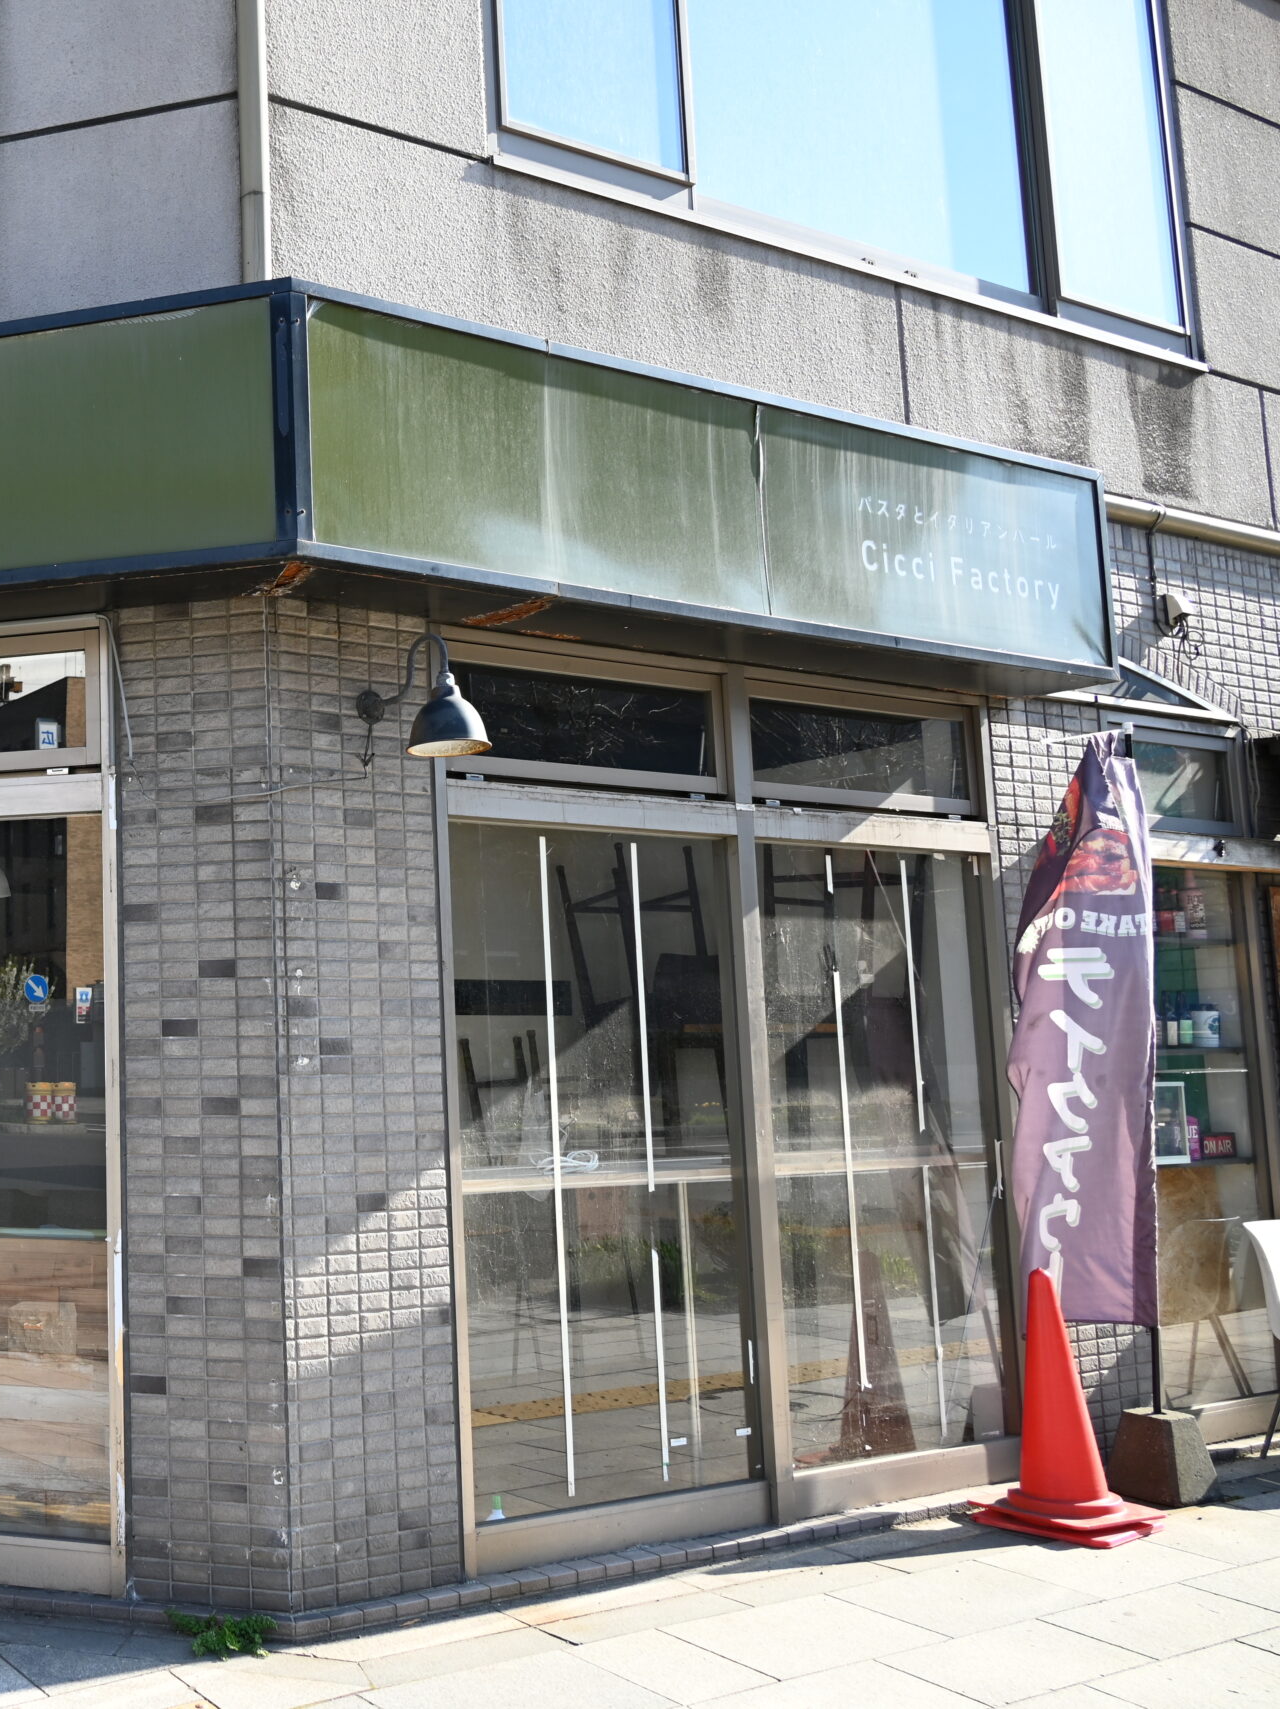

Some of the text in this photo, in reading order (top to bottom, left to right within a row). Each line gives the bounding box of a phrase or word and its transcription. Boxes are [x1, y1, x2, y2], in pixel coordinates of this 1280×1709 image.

[861, 539, 1060, 610] Cicci Factory
[1203, 1140, 1217, 1154] ON
[1217, 1139, 1233, 1153] AIR
